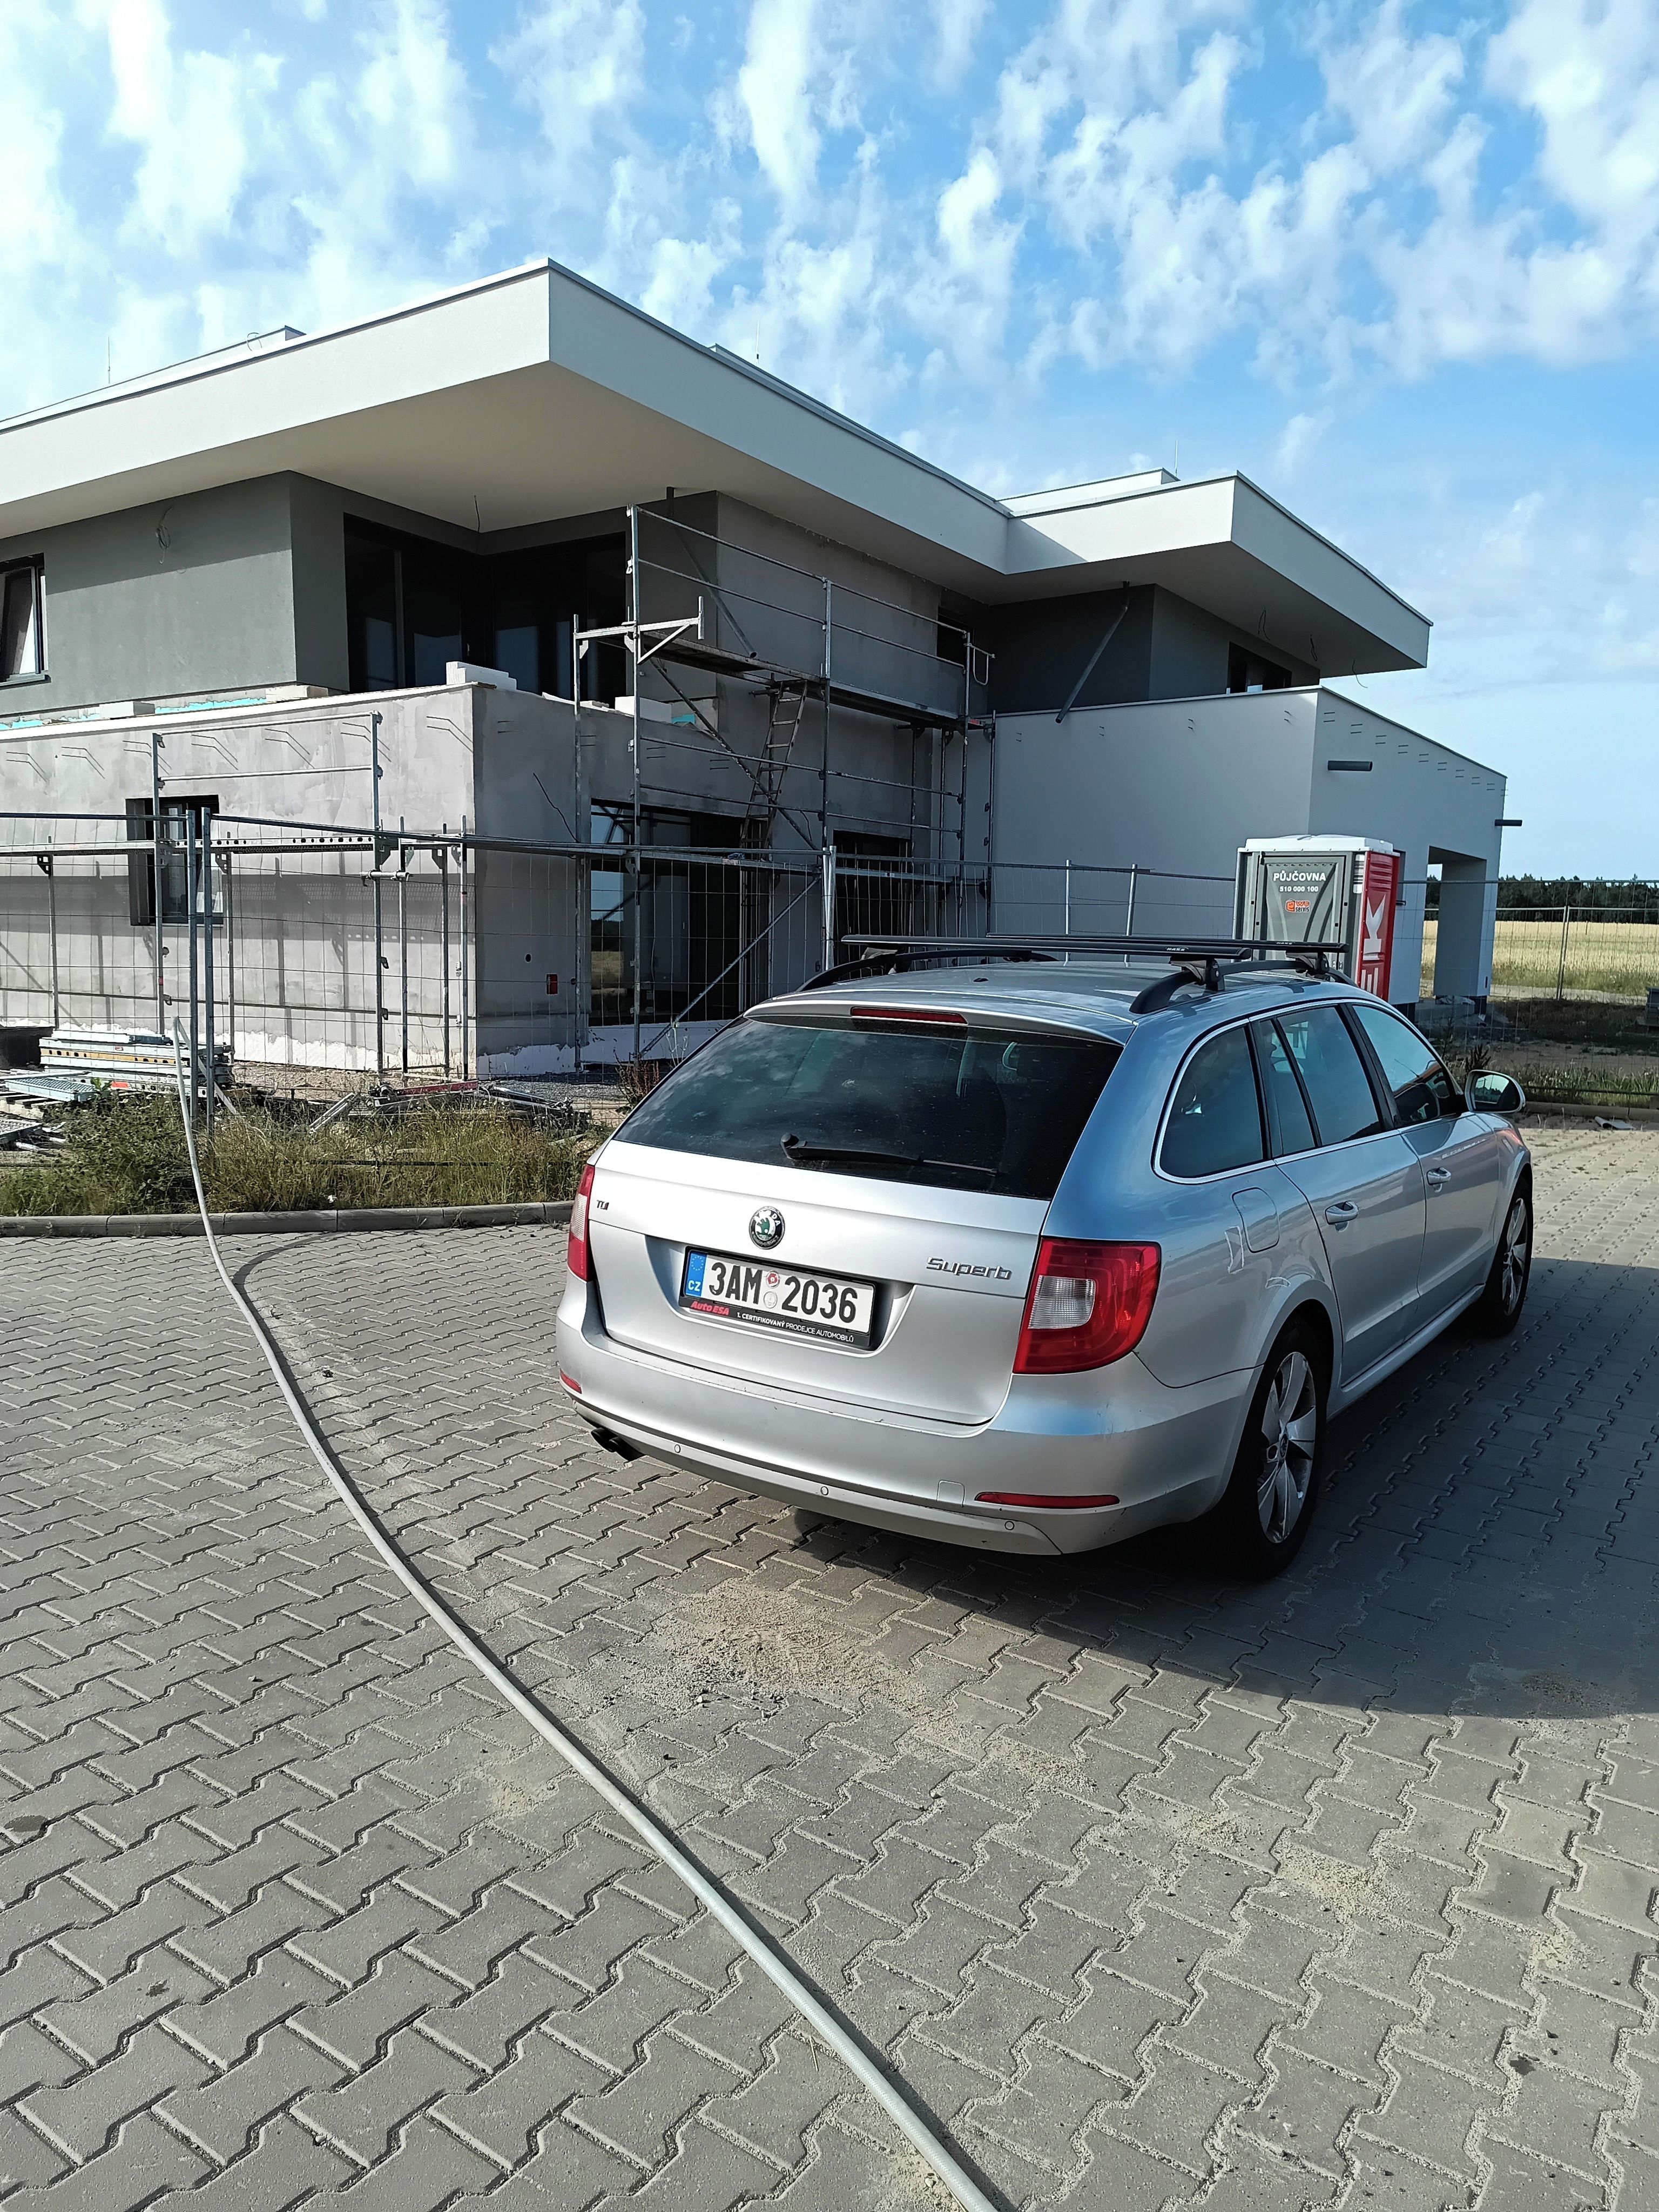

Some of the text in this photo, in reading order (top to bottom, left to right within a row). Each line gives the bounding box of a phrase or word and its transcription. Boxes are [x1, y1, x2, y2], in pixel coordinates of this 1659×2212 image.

[1273, 870, 1326, 881] PŮJČOVNA
[926, 1257, 1012, 1280] Superb
[687, 1280, 701, 1292] CZ
[709, 1262, 858, 1323] 3AM 2036
[691, 1300, 730, 1316] Auto ESA
[741, 1313, 785, 1327] CERTIFIKOVANÝ
[785, 1322, 816, 1334] PRODEJCE
[815, 1329, 854, 1343] AUTOMOBILŮ
